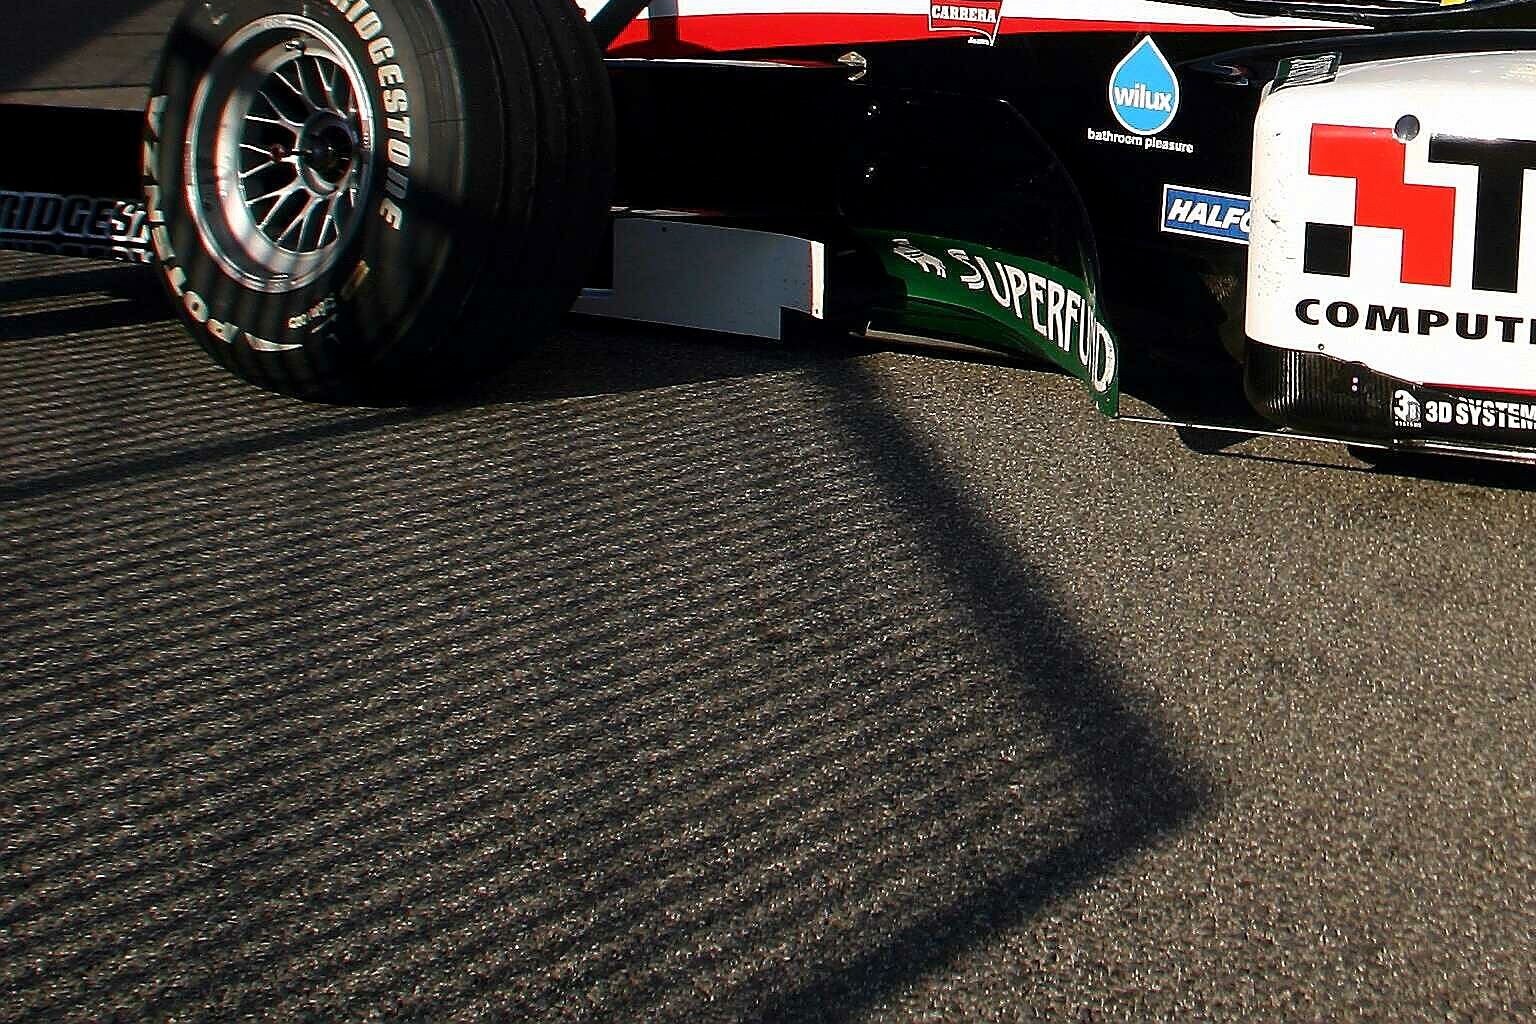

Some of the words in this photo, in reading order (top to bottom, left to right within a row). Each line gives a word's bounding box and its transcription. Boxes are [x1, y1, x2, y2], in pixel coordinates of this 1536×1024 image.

[932, 5, 997, 23] CARRERA
[1114, 82, 1172, 112] wilux
[1088, 128, 1142, 146] bathroom
[1145, 137, 1193, 154] pleasure
[947, 249, 1115, 392] SUPERFUND
[1425, 401, 1452, 424] 3D
